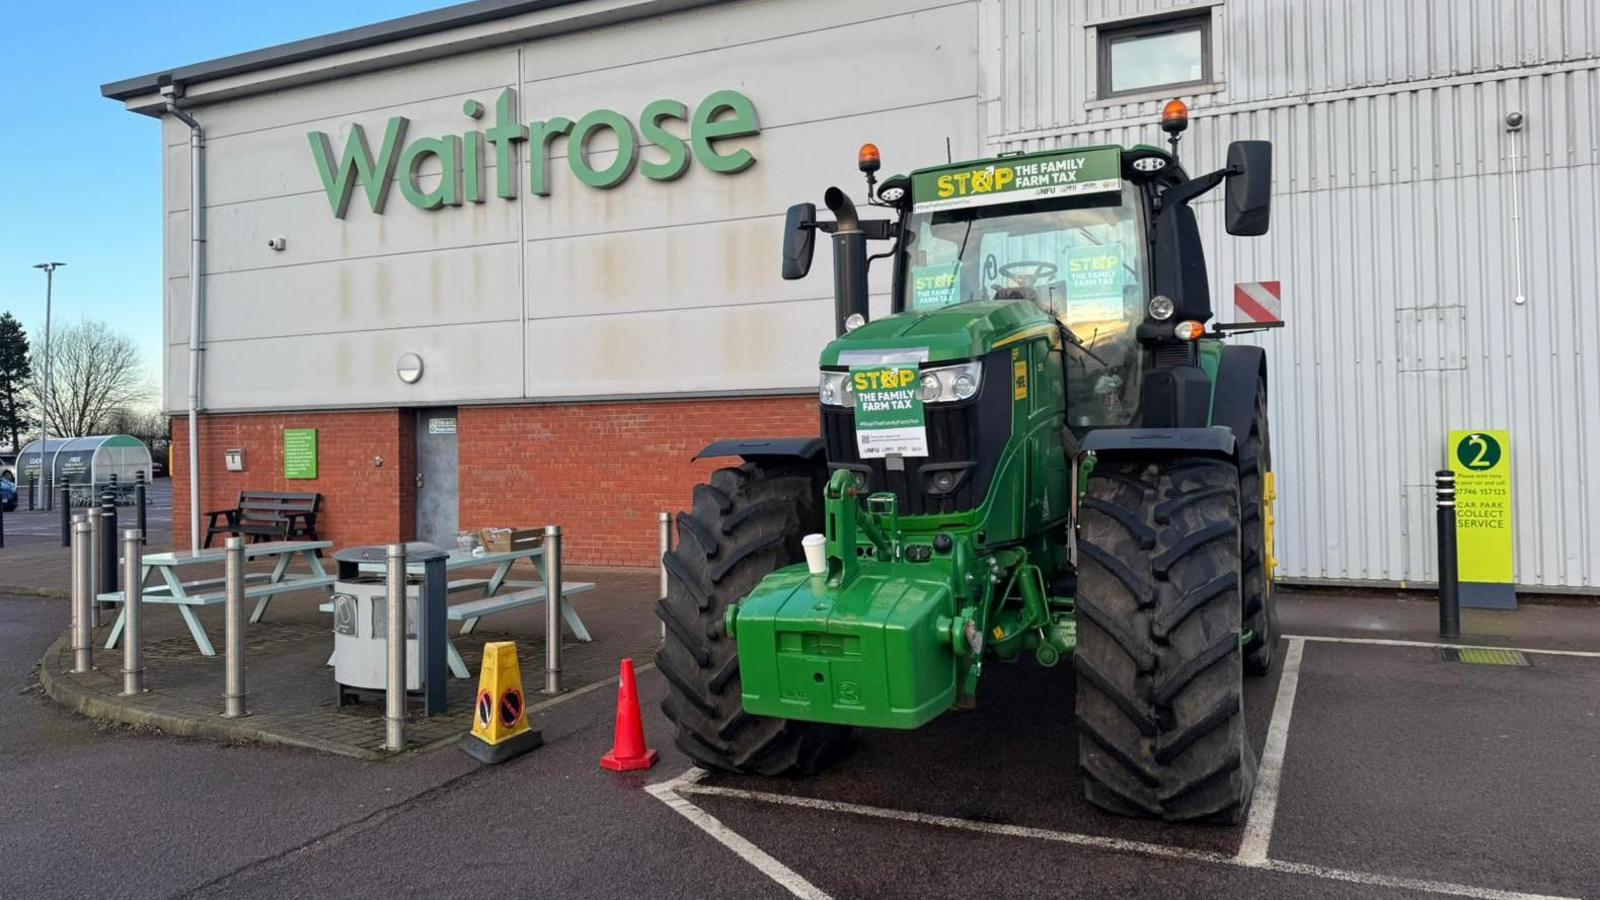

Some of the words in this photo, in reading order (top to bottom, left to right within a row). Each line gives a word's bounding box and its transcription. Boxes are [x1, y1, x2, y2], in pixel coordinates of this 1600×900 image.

[306, 86, 761, 220] Waitrose
[1015, 163, 1038, 176] THE
[1041, 158, 1085, 173] FAMILY
[937, 166, 1014, 198] STOP
[1015, 174, 1049, 188] FARM
[1052, 170, 1077, 183] TAX
[1070, 255, 1119, 272] STOP
[1071, 272, 1087, 280] THE
[1087, 270, 1117, 279] FAMILY
[1074, 278, 1098, 287] FARM
[1099, 277, 1115, 286] TAX
[918, 289, 930, 298] THE
[854, 368, 915, 390] STOP
[858, 393, 877, 402] THE
[877, 389, 914, 401] FAMILY
[863, 401, 890, 412] FARM
[891, 399, 912, 410] TAX
[1468, 437, 1490, 467] 2
[1457, 509, 1504, 518] COLLECT
[1458, 519, 1504, 529] SERVICE
